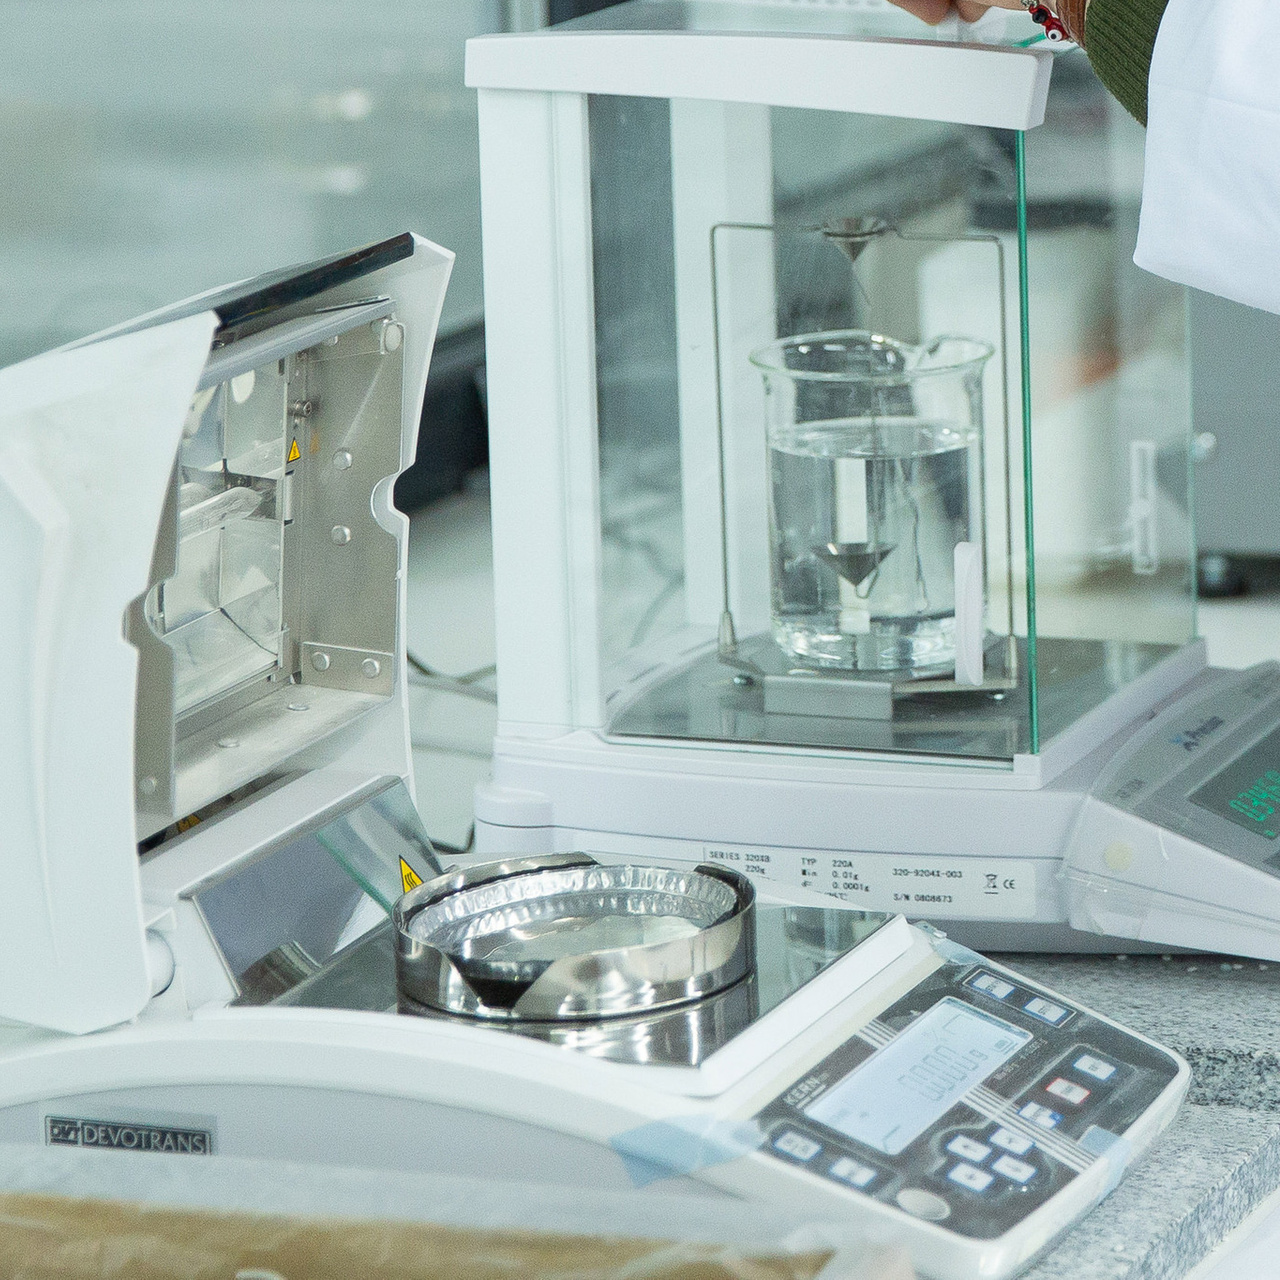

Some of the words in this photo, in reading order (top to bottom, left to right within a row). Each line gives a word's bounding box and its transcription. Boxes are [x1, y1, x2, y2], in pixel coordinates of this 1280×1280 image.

[709, 850, 740, 863] SERIES
[801, 857, 817, 867] TYP
[83, 1125, 205, 1154] DEVOTRANS
